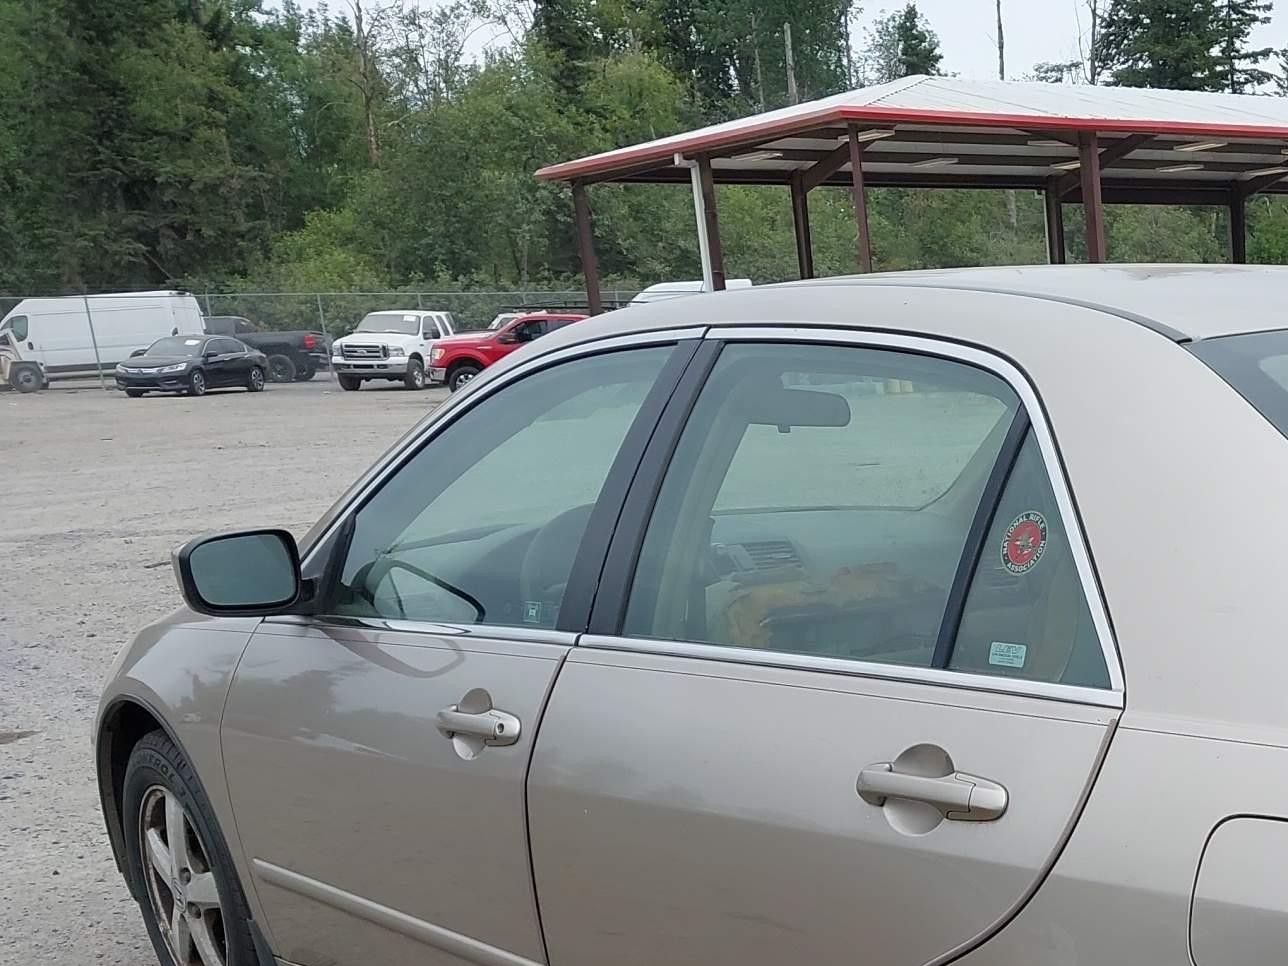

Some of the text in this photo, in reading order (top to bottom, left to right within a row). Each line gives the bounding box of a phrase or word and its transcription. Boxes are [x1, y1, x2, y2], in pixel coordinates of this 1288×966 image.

[1002, 513, 1046, 555] NATIONAL RIFLE
[1006, 540, 1046, 572] ASSOCIATION
